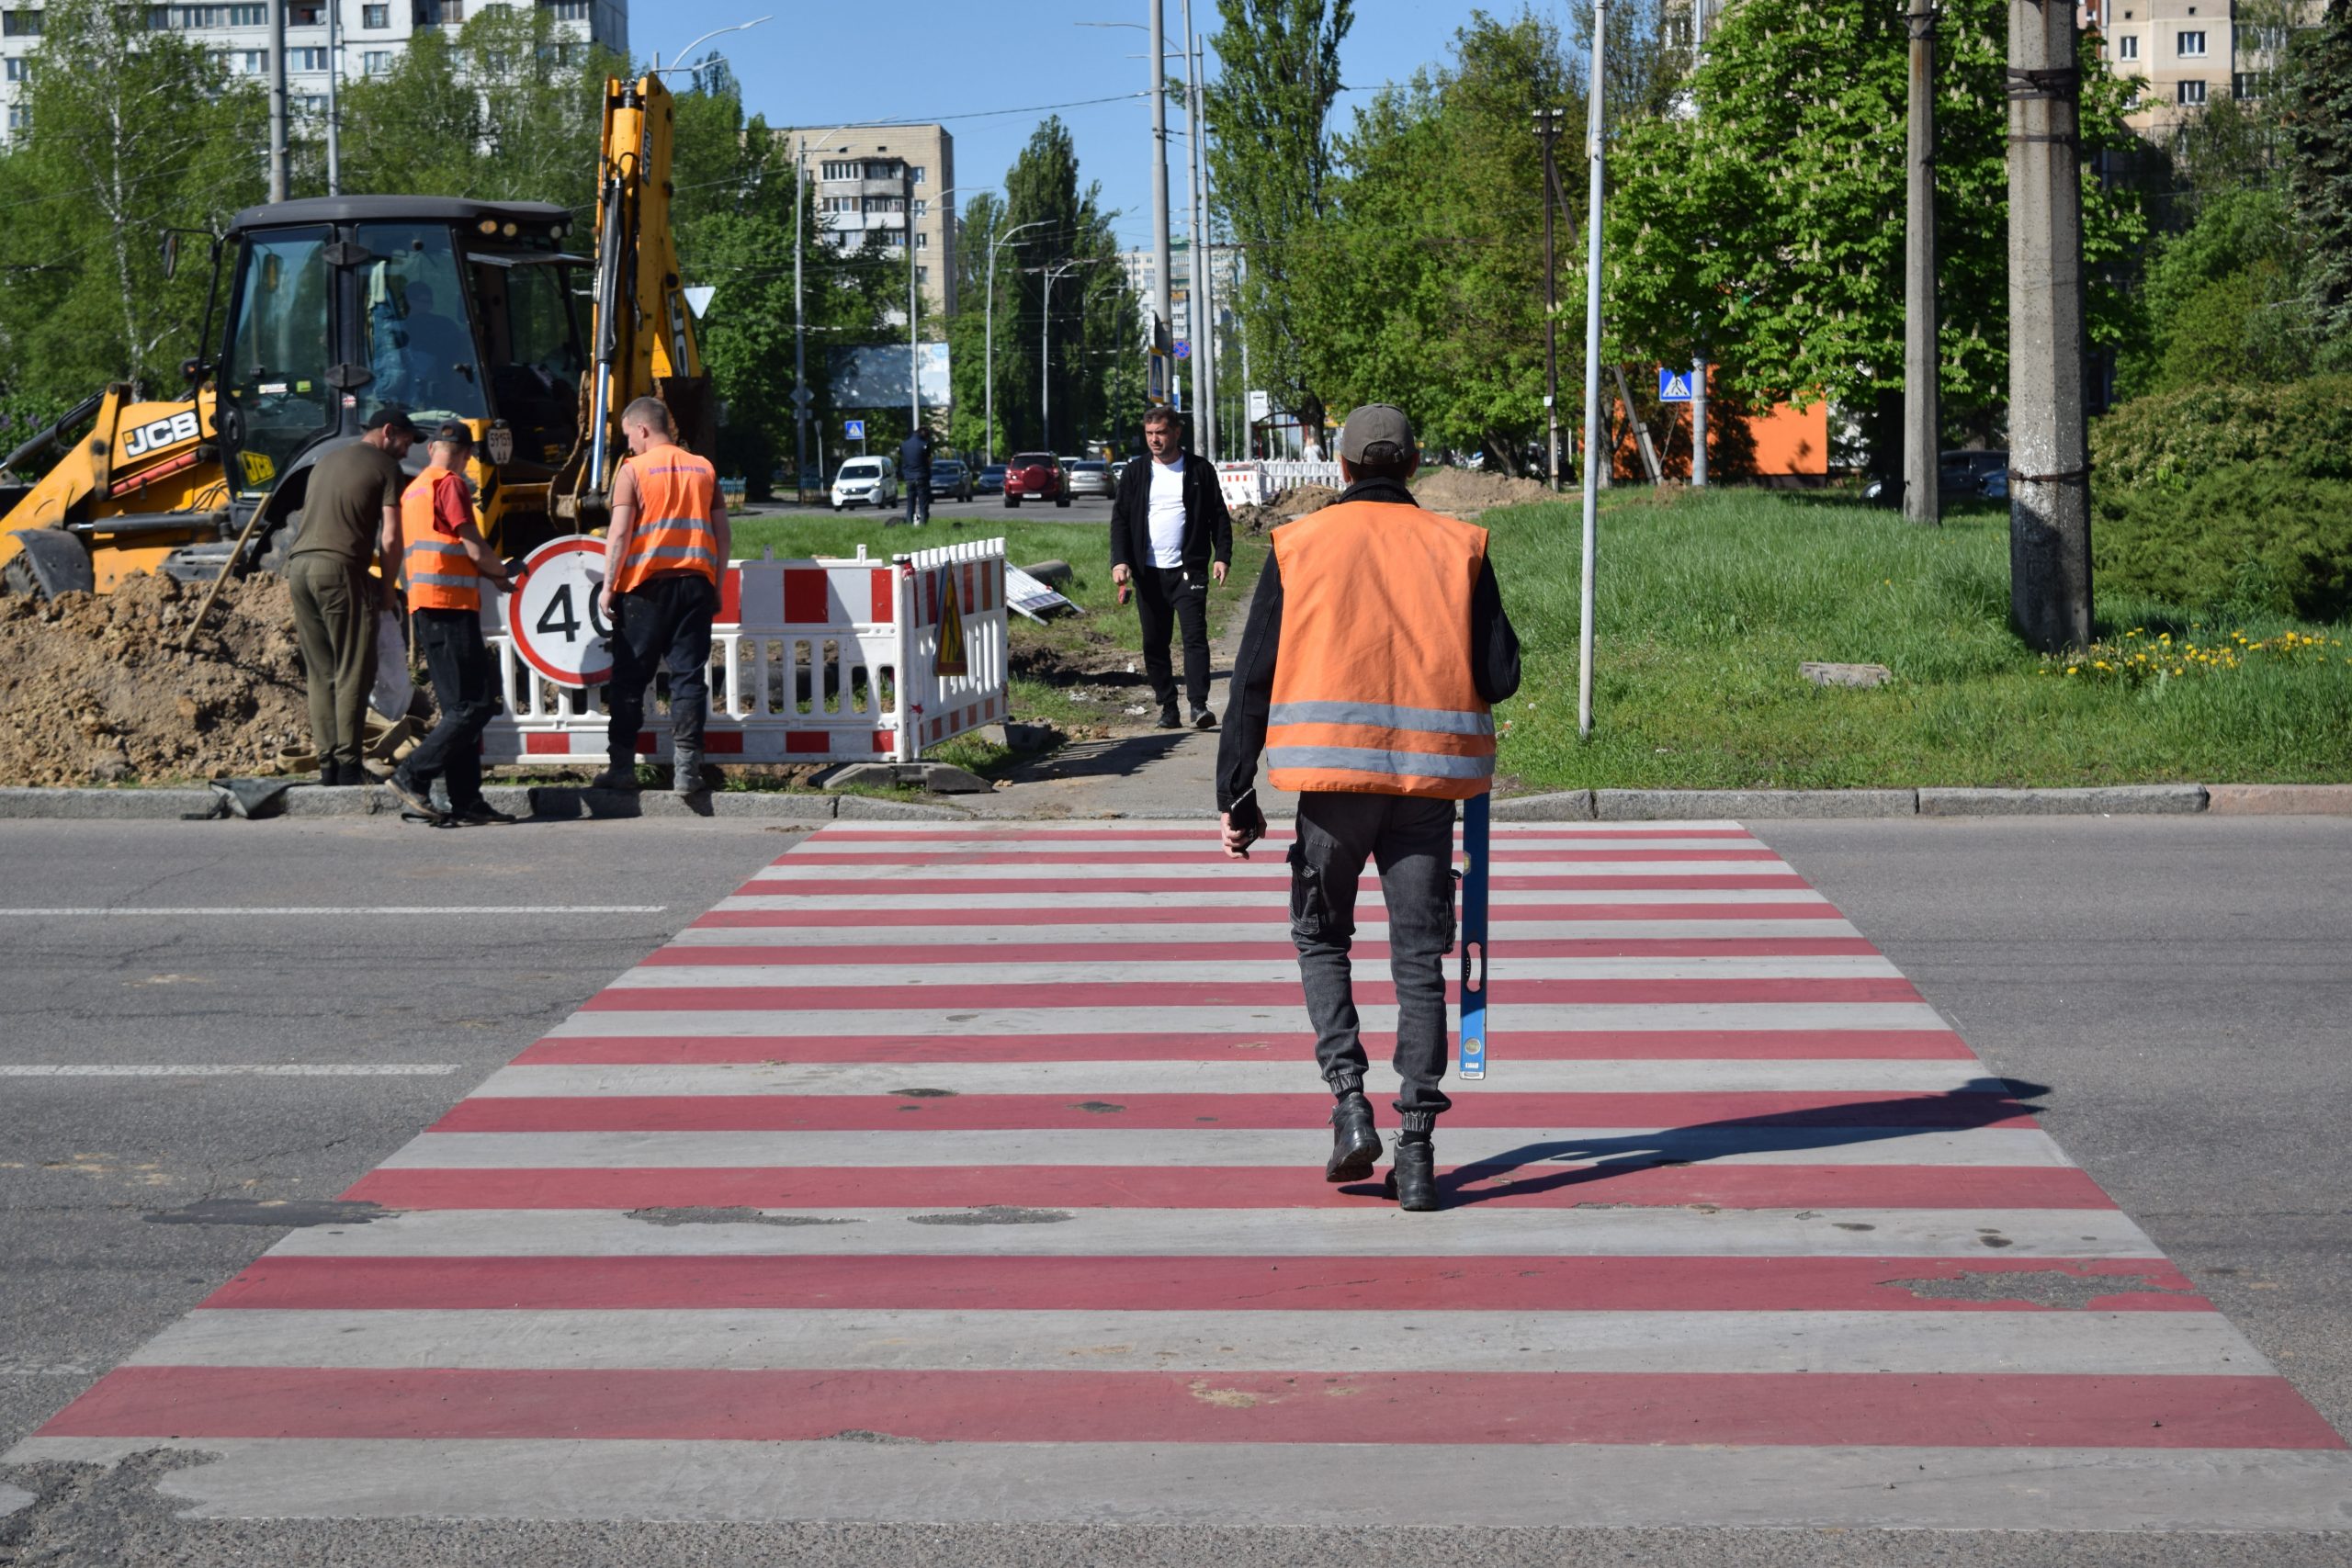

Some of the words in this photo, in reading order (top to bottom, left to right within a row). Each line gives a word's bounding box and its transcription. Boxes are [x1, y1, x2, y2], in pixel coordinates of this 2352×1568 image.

[670, 294, 689, 377] JC
[125, 412, 199, 456] JCB
[244, 454, 274, 482] JCB
